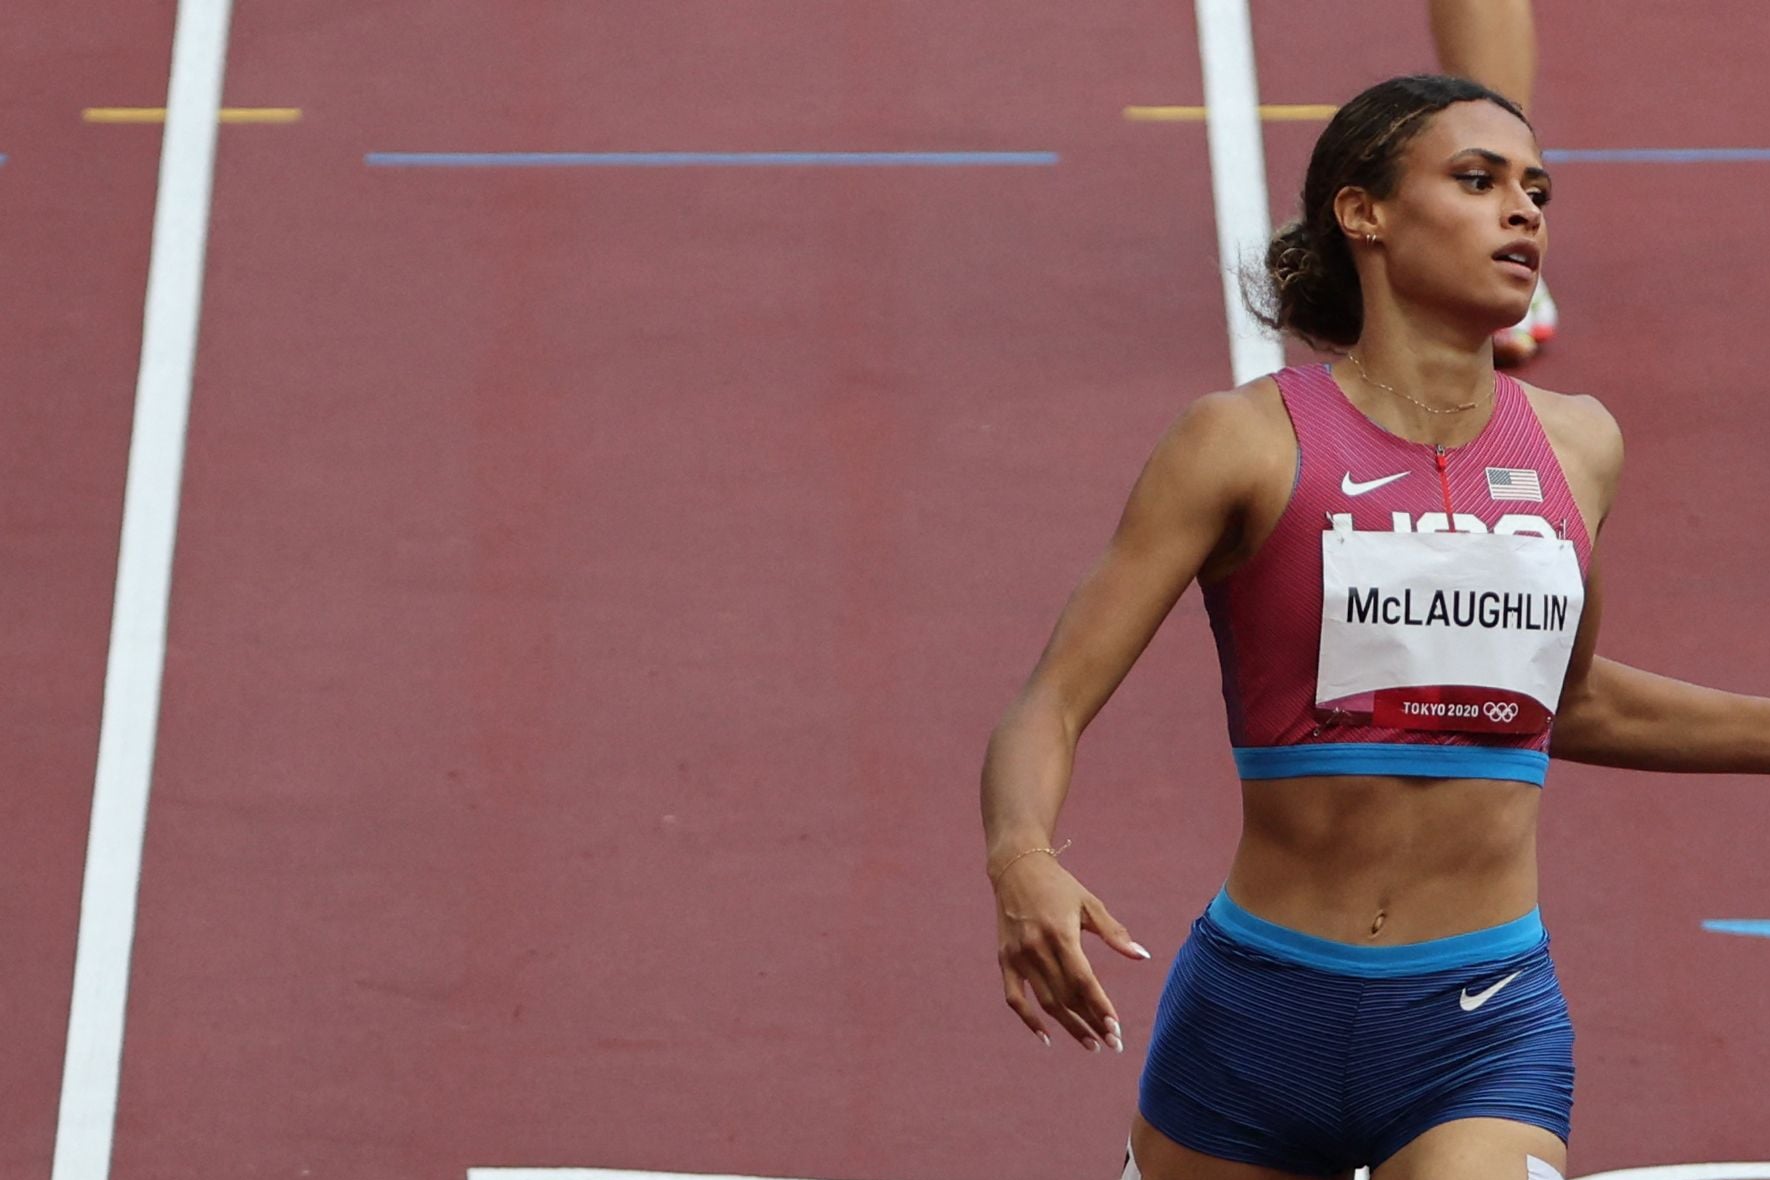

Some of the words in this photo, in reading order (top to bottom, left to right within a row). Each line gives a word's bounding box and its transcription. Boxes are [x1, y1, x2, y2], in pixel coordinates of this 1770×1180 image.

[1346, 586, 1568, 632] McLAUGHLIN
[1403, 701, 1445, 716] TOKYO
[1448, 703, 1479, 717] 2020
